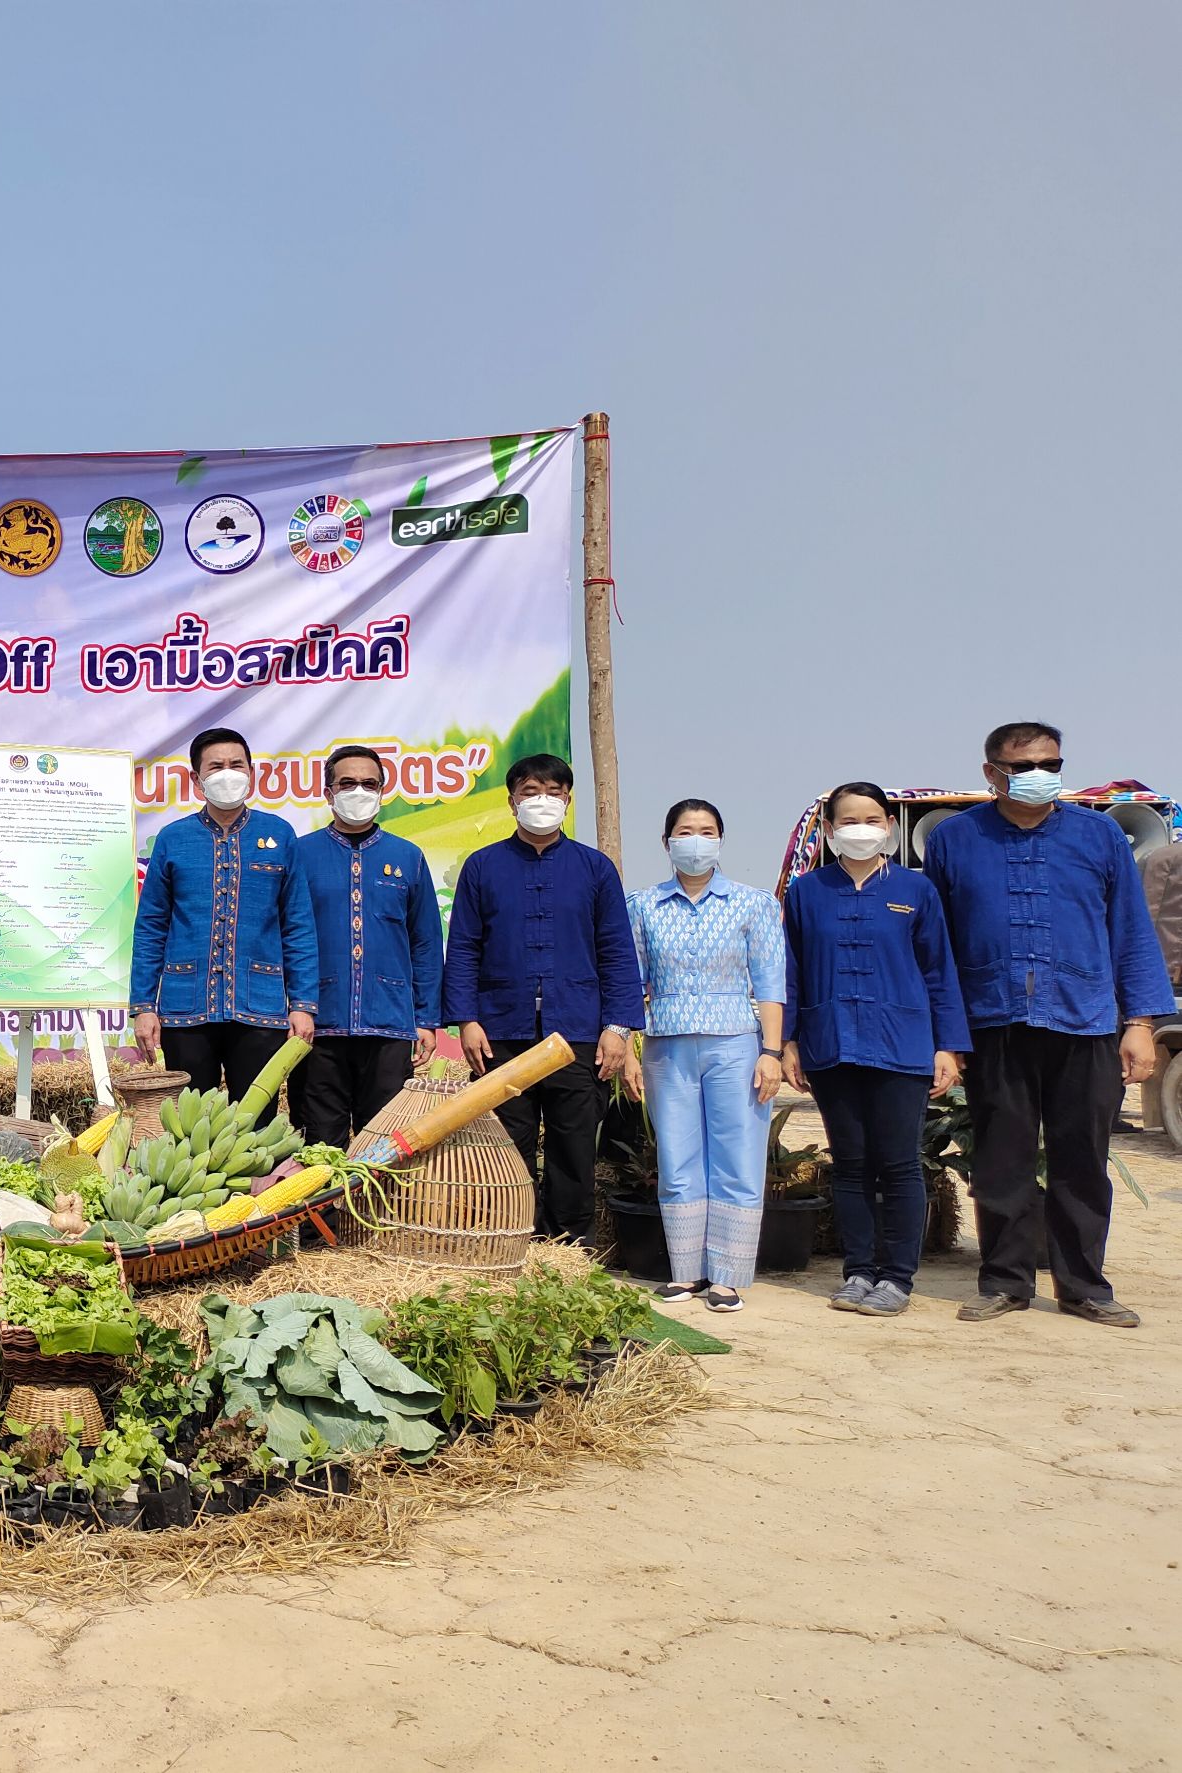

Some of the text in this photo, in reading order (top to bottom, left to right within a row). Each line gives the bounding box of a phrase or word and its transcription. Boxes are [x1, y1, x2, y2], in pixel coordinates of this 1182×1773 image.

[313, 532, 338, 540] GOALS
[398, 501, 520, 538] earthsafe
[85, 617, 406, 688] เอามื้อสามัคคี
